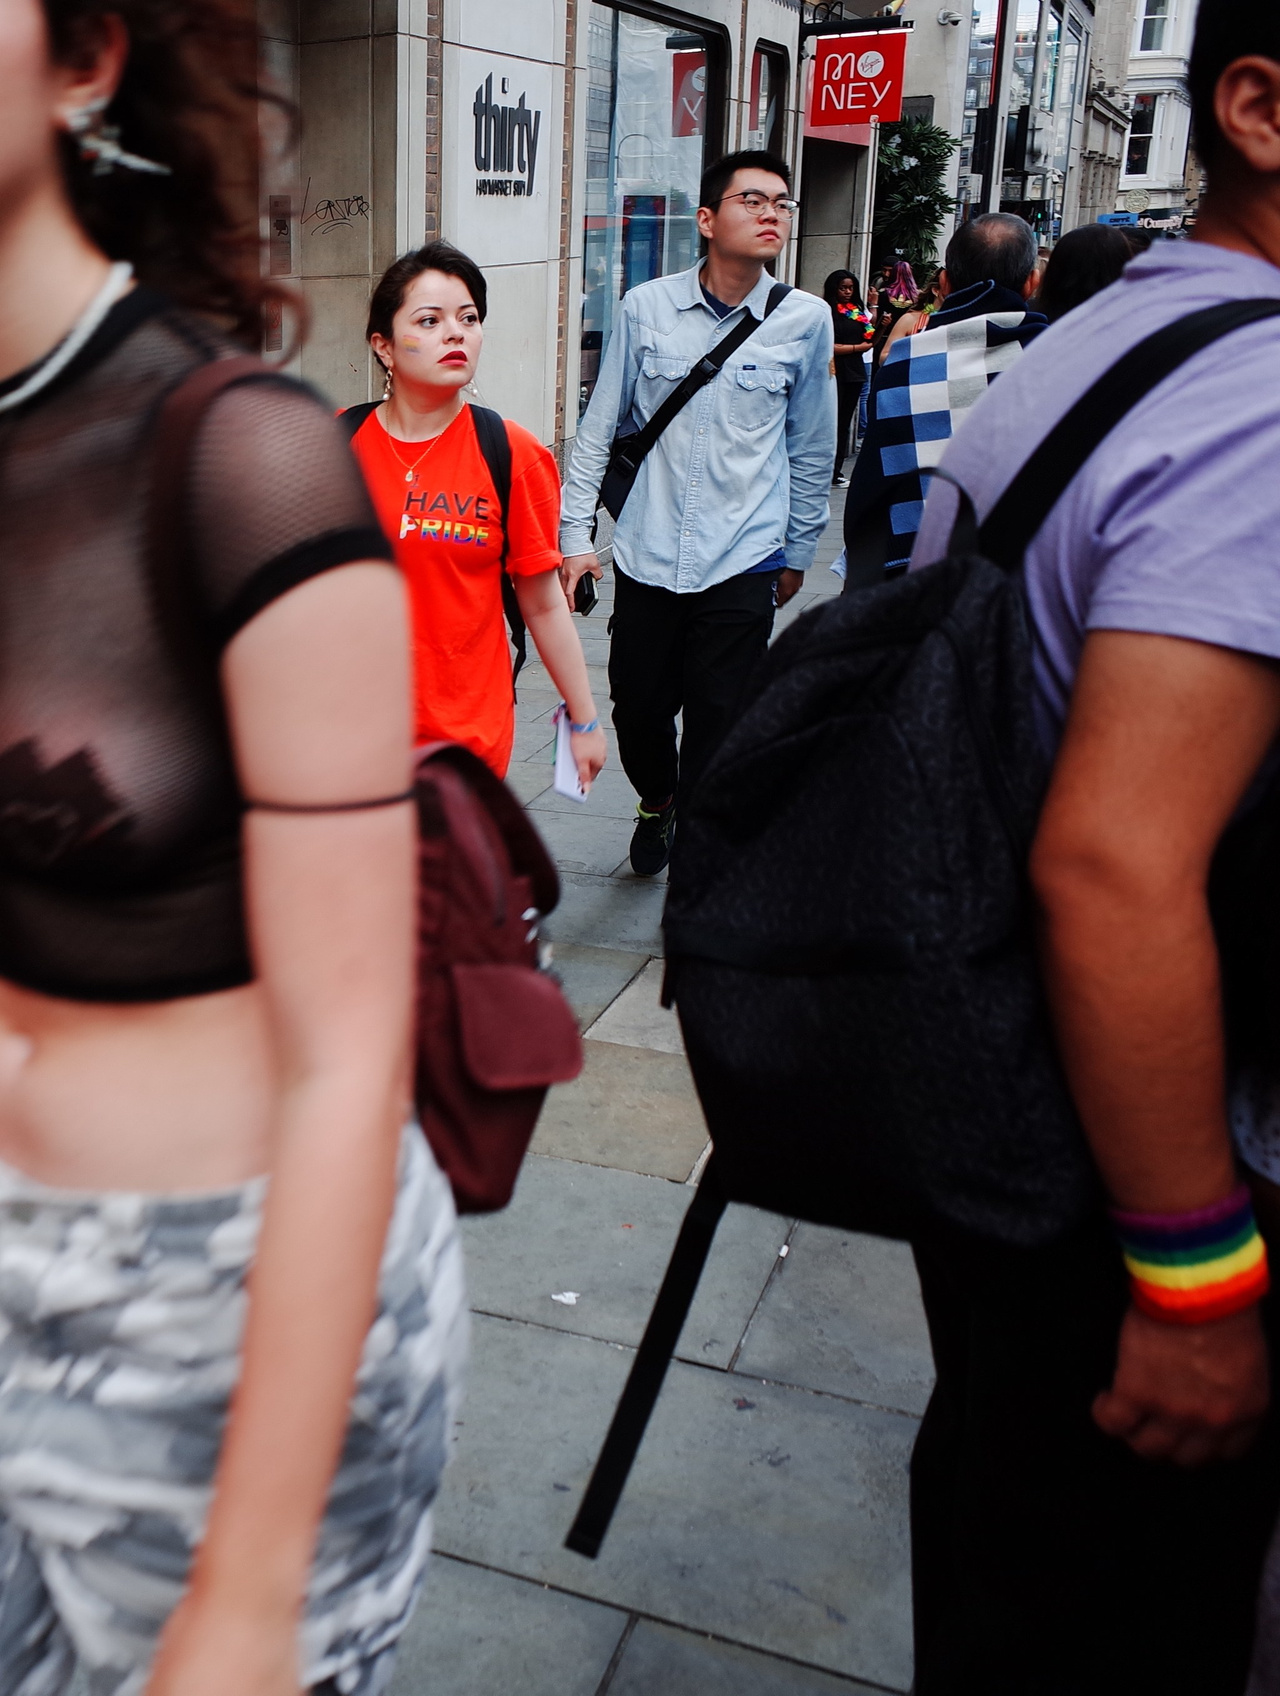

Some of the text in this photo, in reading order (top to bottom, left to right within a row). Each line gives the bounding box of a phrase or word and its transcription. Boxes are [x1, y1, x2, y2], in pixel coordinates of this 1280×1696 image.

[821, 80, 892, 111] NEY
[473, 71, 541, 196] thirty
[476, 179, 512, 196] HAYMARKET
[405, 491, 489, 520] HAVE
[400, 513, 489, 547] PRIDE
